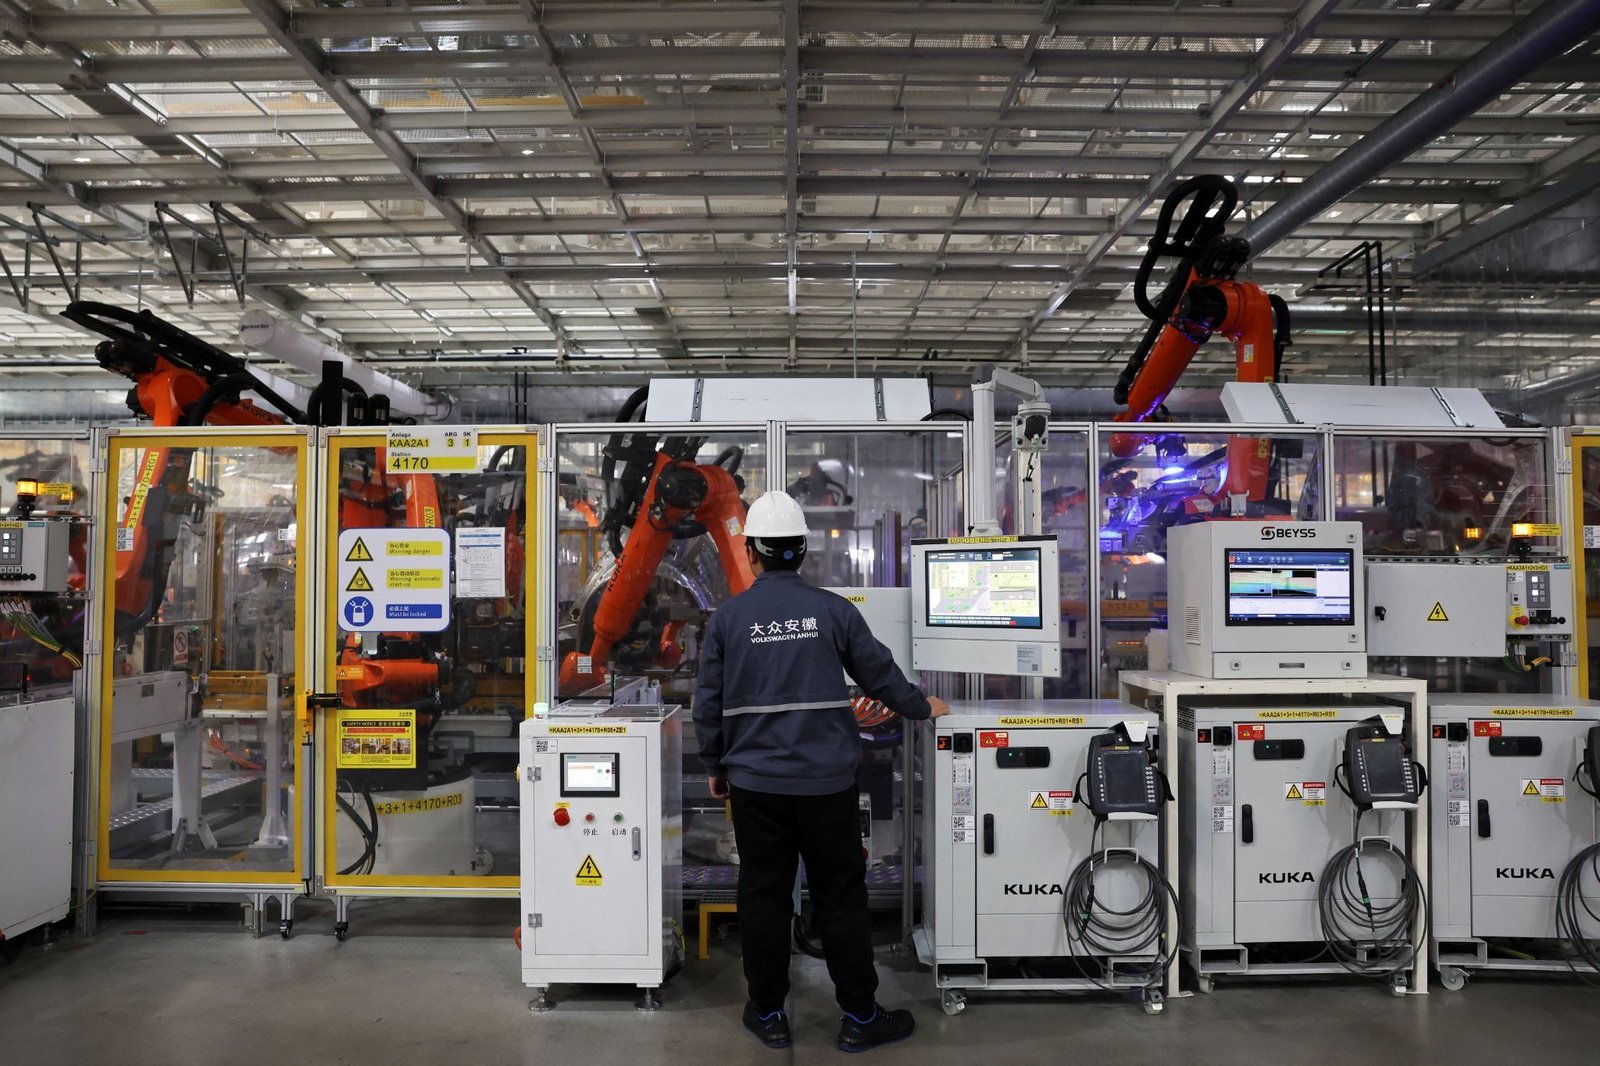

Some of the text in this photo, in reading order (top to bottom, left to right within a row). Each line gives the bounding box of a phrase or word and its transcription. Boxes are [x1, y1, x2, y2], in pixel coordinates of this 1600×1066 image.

[389, 439, 470, 447] KAA2A1 3 1
[392, 457, 429, 469] 4170
[1276, 528, 1316, 538] BEYSS
[749, 617, 818, 637] 大众安徽
[750, 631, 819, 644] VOLKSWAGEN ANHUI
[376, 794, 464, 814] +3+1+4170+R03
[583, 828, 599, 836] 停止
[611, 827, 627, 836] 启动
[1259, 871, 1315, 884] KUKA
[1496, 868, 1555, 879] KUKA
[1004, 884, 1064, 895] KUKA
